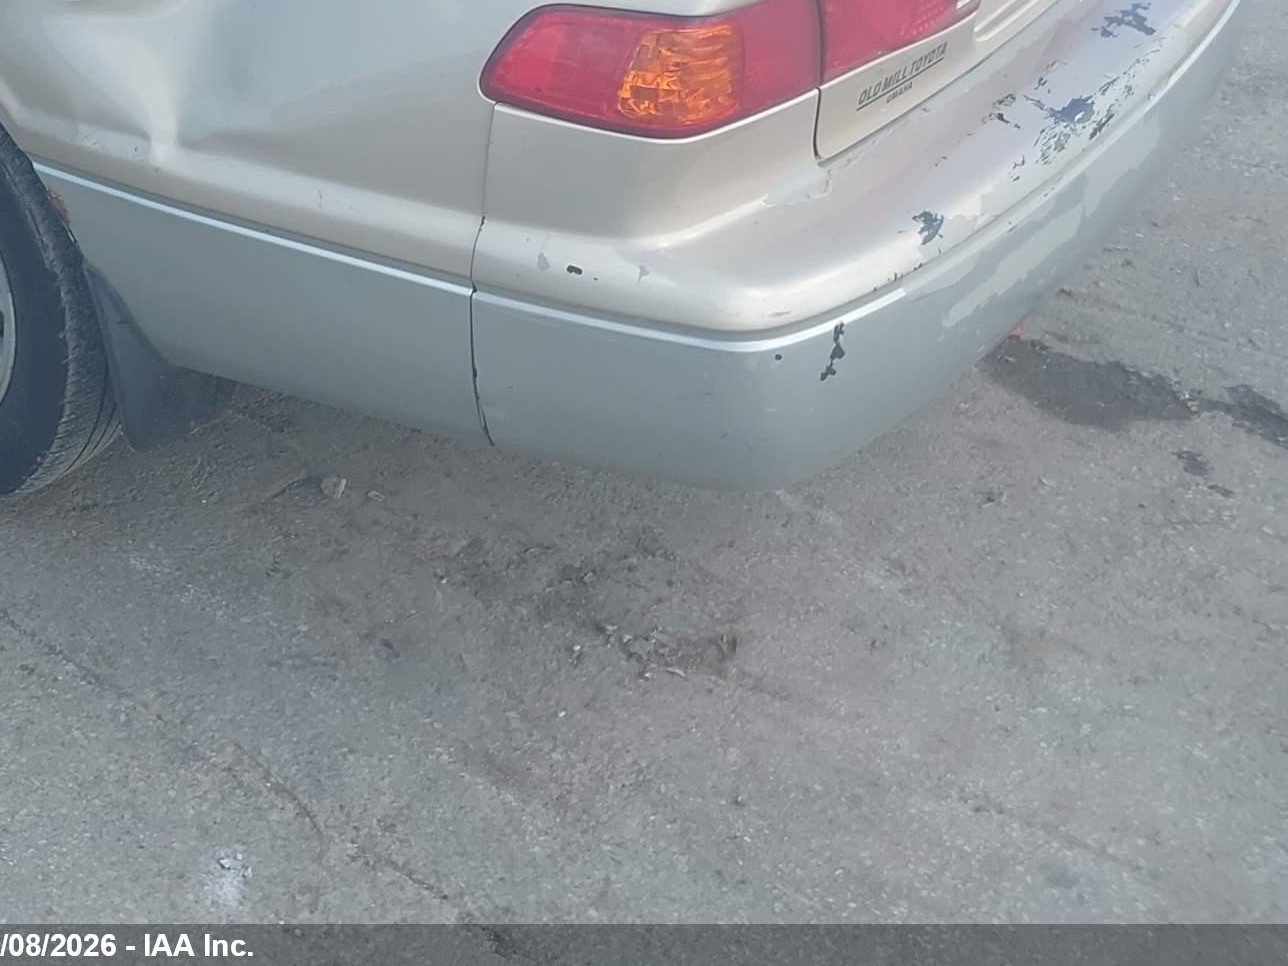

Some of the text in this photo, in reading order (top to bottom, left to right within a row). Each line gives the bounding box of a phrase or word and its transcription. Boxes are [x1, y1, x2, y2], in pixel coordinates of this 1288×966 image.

[858, 41, 948, 105] OLD MILL TOYOTA
